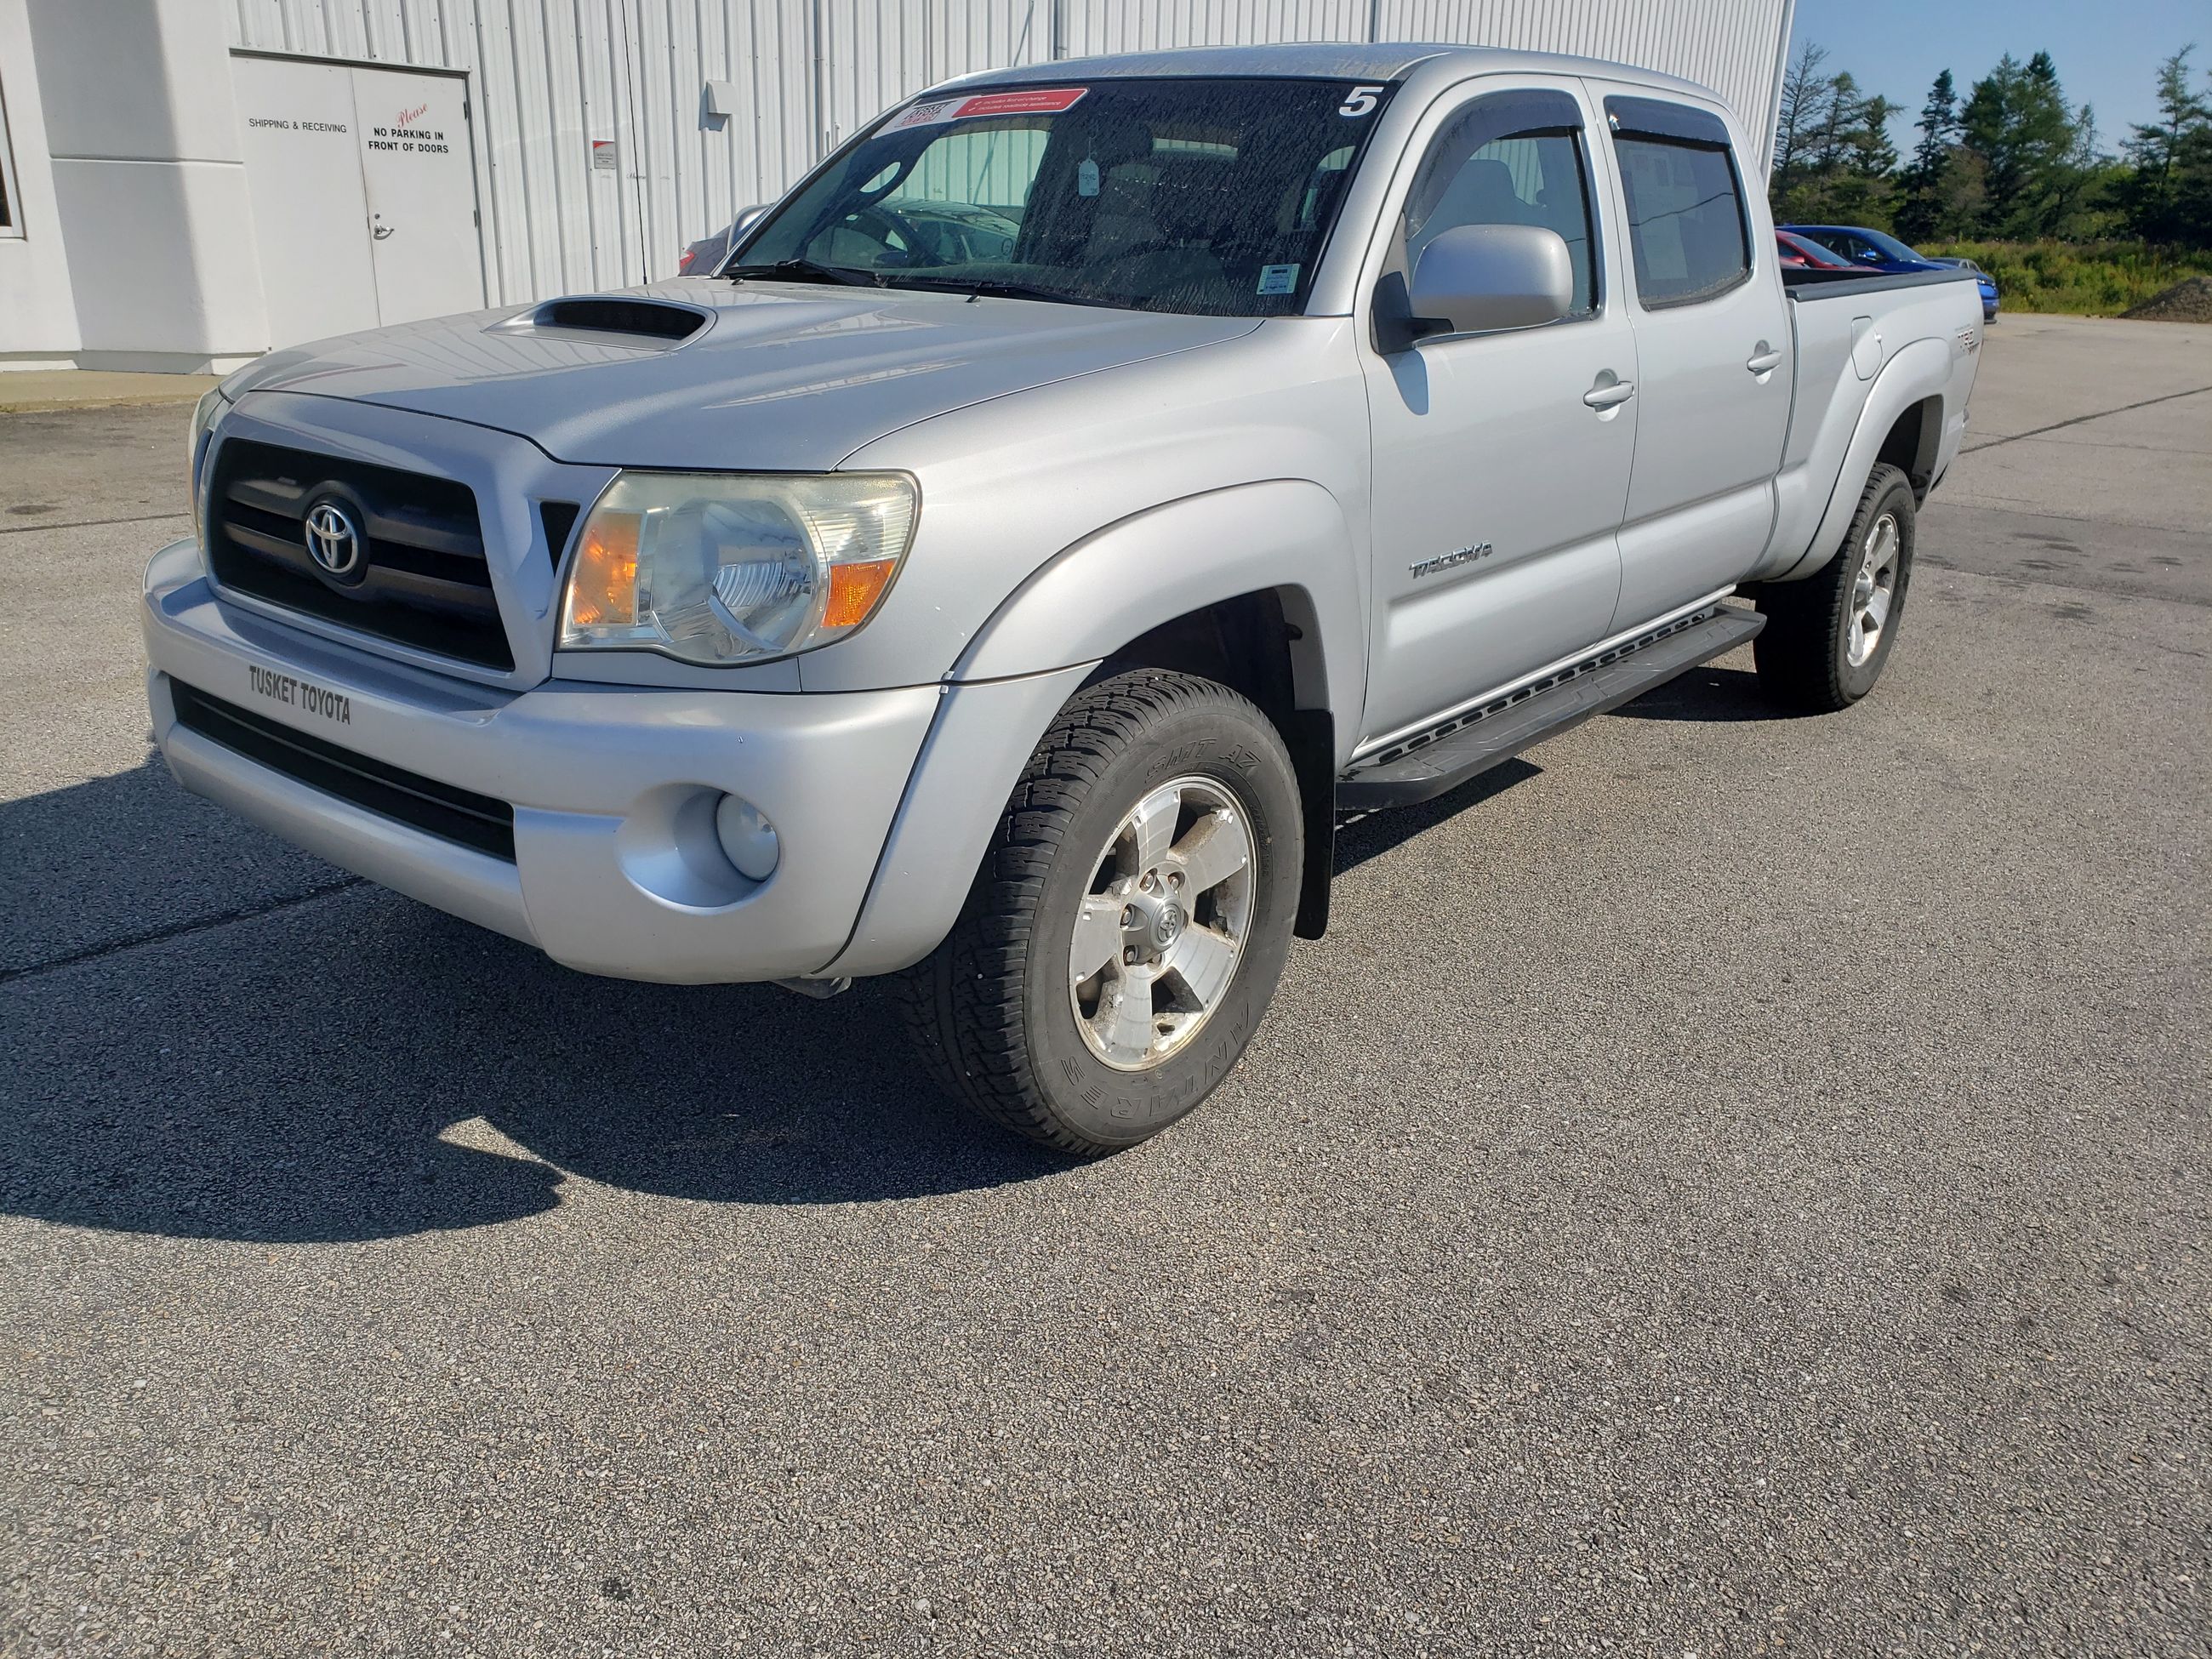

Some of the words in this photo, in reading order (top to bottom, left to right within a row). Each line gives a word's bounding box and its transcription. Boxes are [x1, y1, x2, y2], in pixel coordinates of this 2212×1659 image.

[1338, 86, 1385, 117] 5
[248, 117, 290, 130] SHIPPING
[293, 121, 299, 130] &
[302, 122, 348, 134] RECEIVING
[396, 102, 428, 128] Please
[373, 127, 388, 137] NO
[391, 128, 431, 140] PARKING
[435, 131, 444, 141] IN
[368, 140, 399, 151] FRONT
[402, 142, 414, 152] OF
[418, 143, 449, 154] DOORS
[249, 665, 298, 705] TUSKET
[300, 682, 351, 725] TOYOTA
